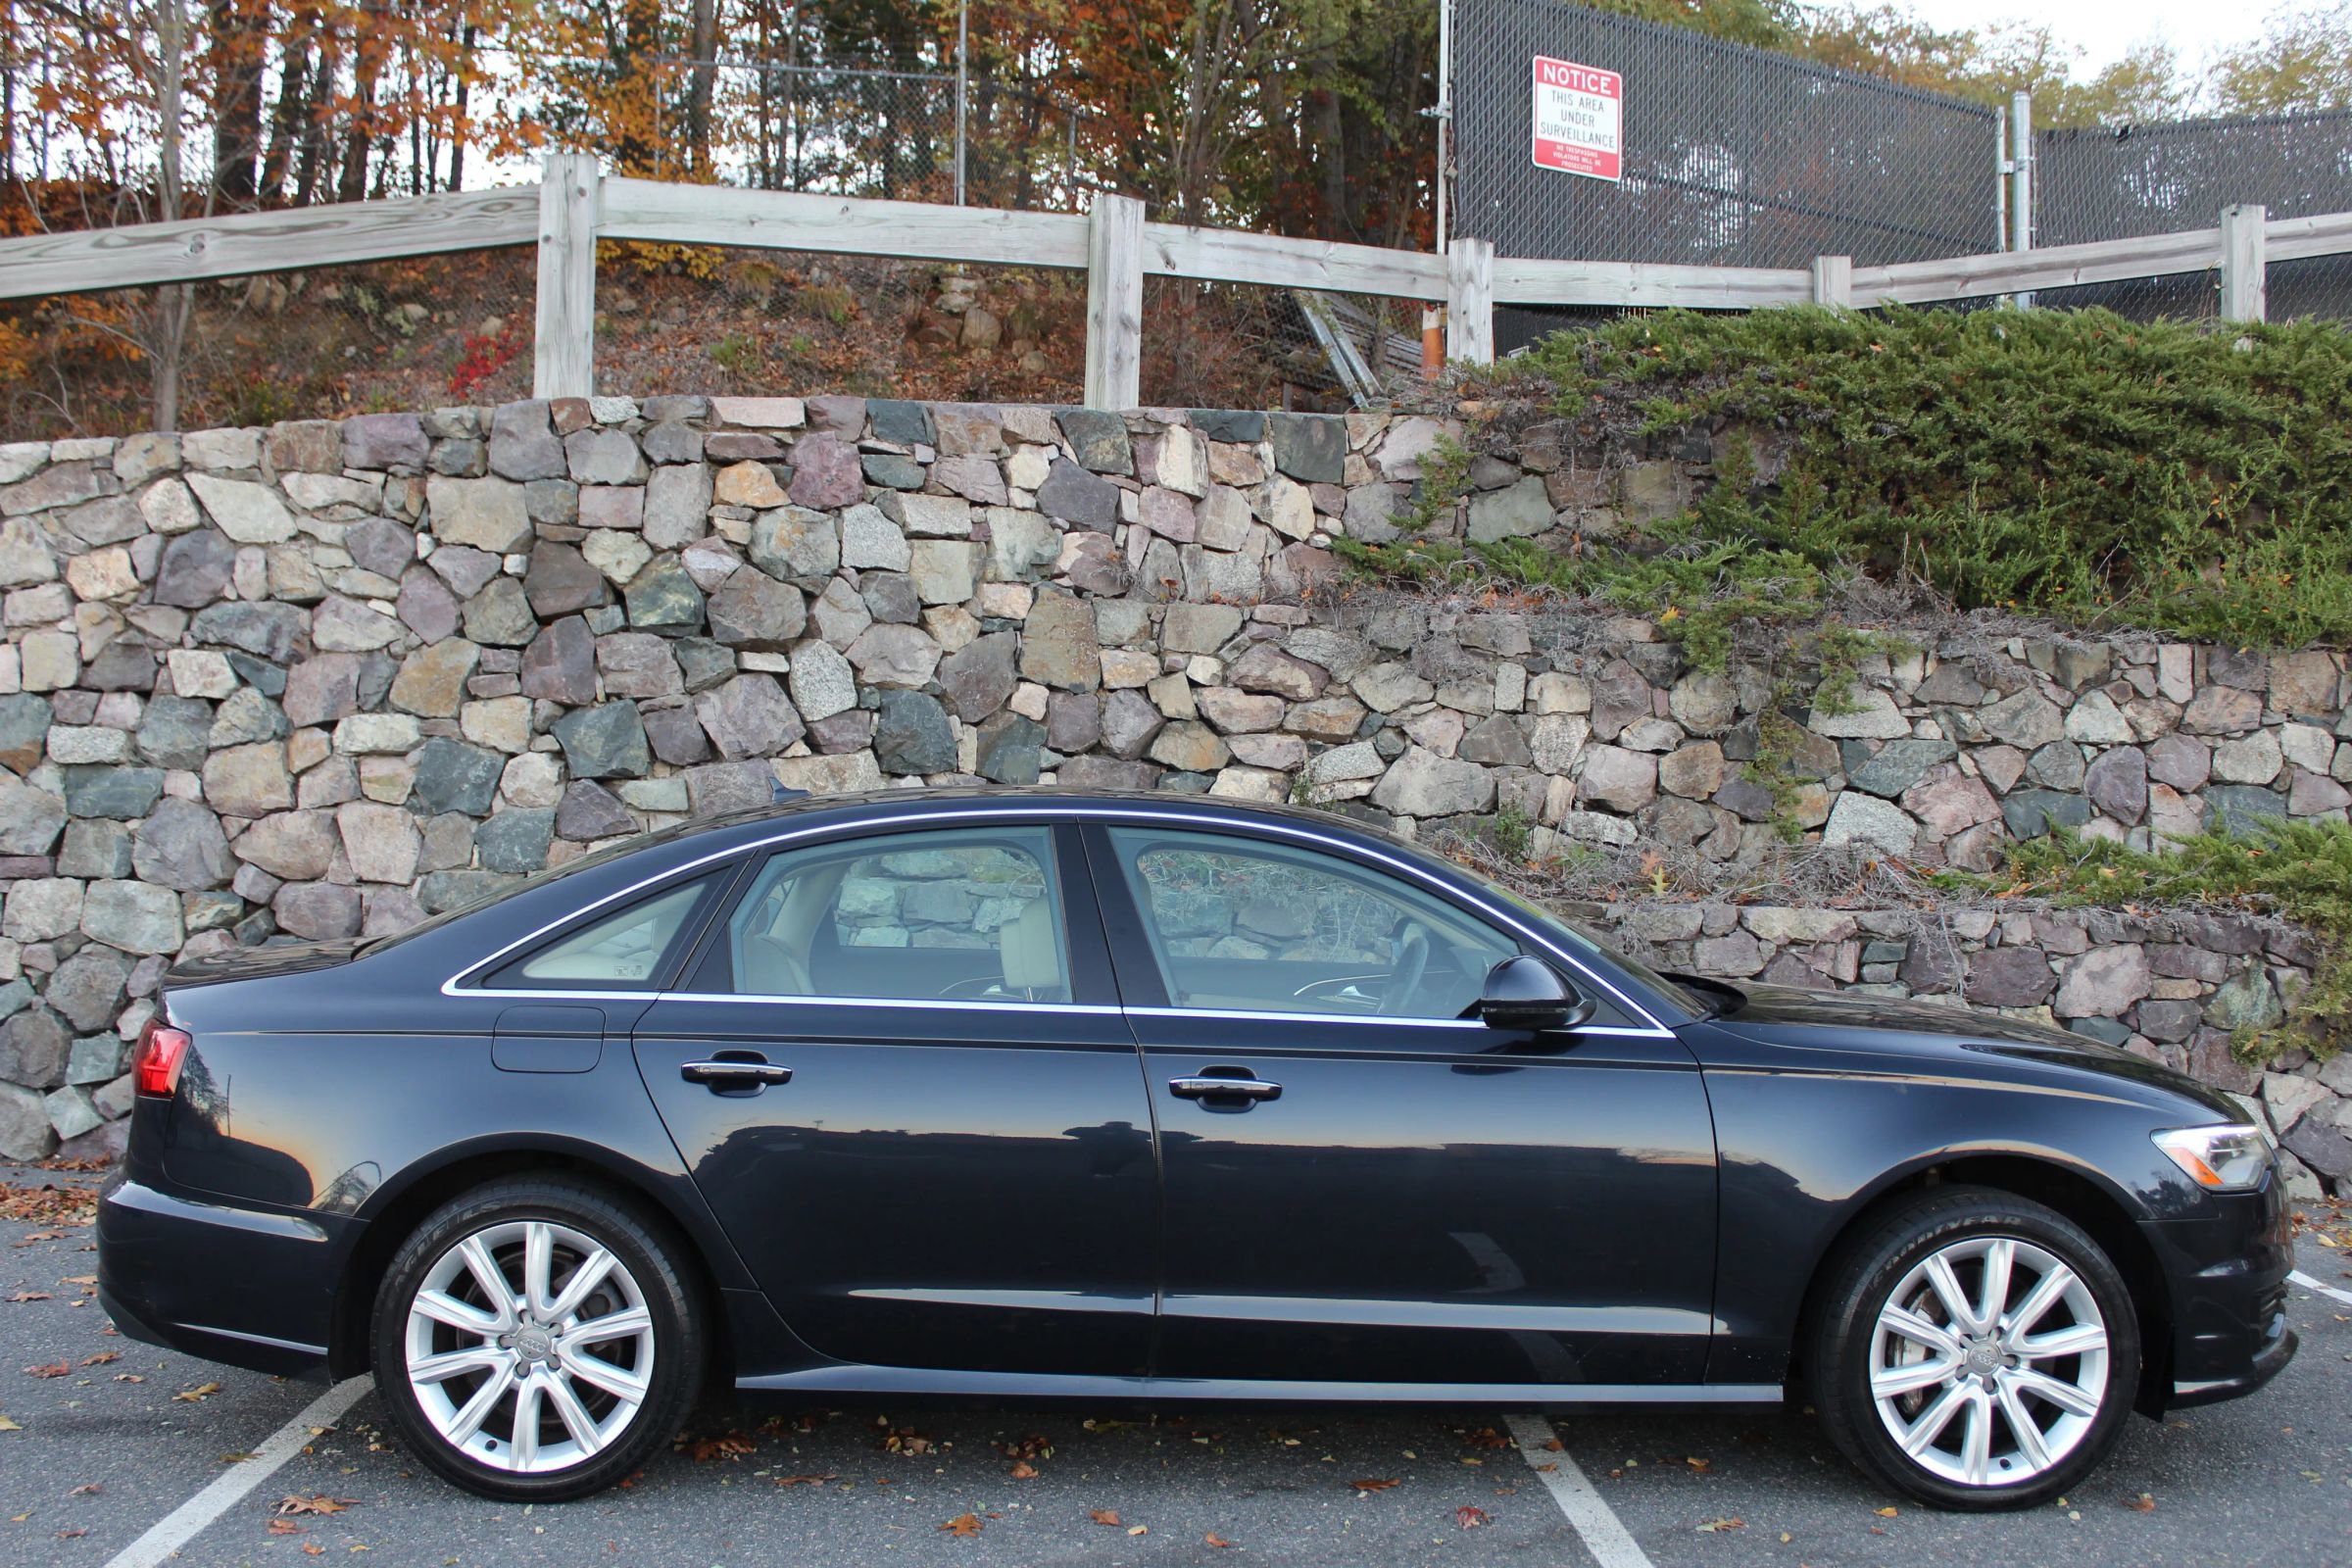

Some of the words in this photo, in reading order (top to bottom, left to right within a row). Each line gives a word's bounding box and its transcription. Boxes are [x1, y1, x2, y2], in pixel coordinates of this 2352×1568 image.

[1544, 63, 1612, 95] NOTICE
[1551, 90, 1574, 107] THIS
[1579, 96, 1604, 113] AREA
[1560, 109, 1595, 127] UNDER
[1540, 121, 1615, 149] SURVEILLANCE
[1552, 151, 1580, 162] VIOLATORS
[1565, 146, 1598, 158] TRESPASSING
[1561, 160, 1593, 172] PROSECUTED
